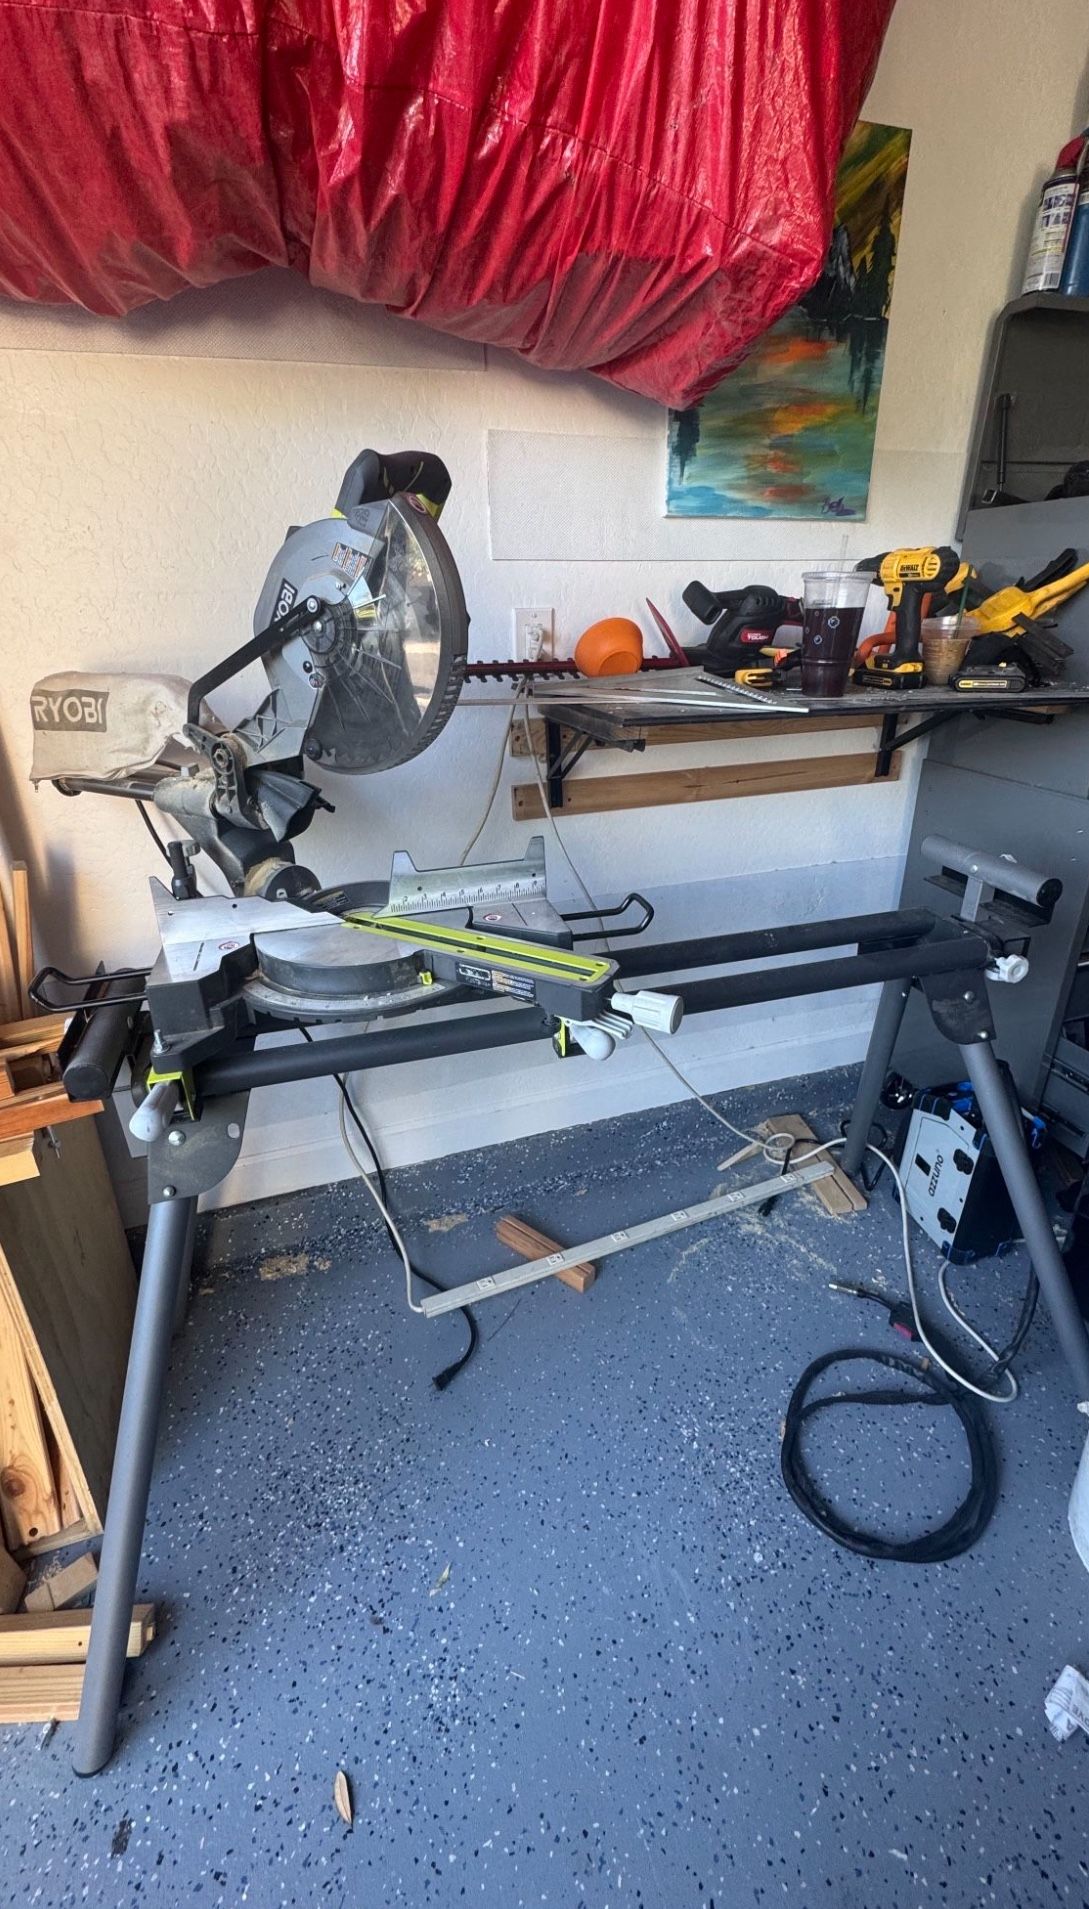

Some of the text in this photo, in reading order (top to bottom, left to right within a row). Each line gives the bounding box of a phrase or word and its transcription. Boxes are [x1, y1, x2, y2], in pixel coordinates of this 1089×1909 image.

[273, 583, 295, 622] YOBI
[31, 696, 104, 724] RYOBI
[928, 1154, 944, 1198] azzuno
